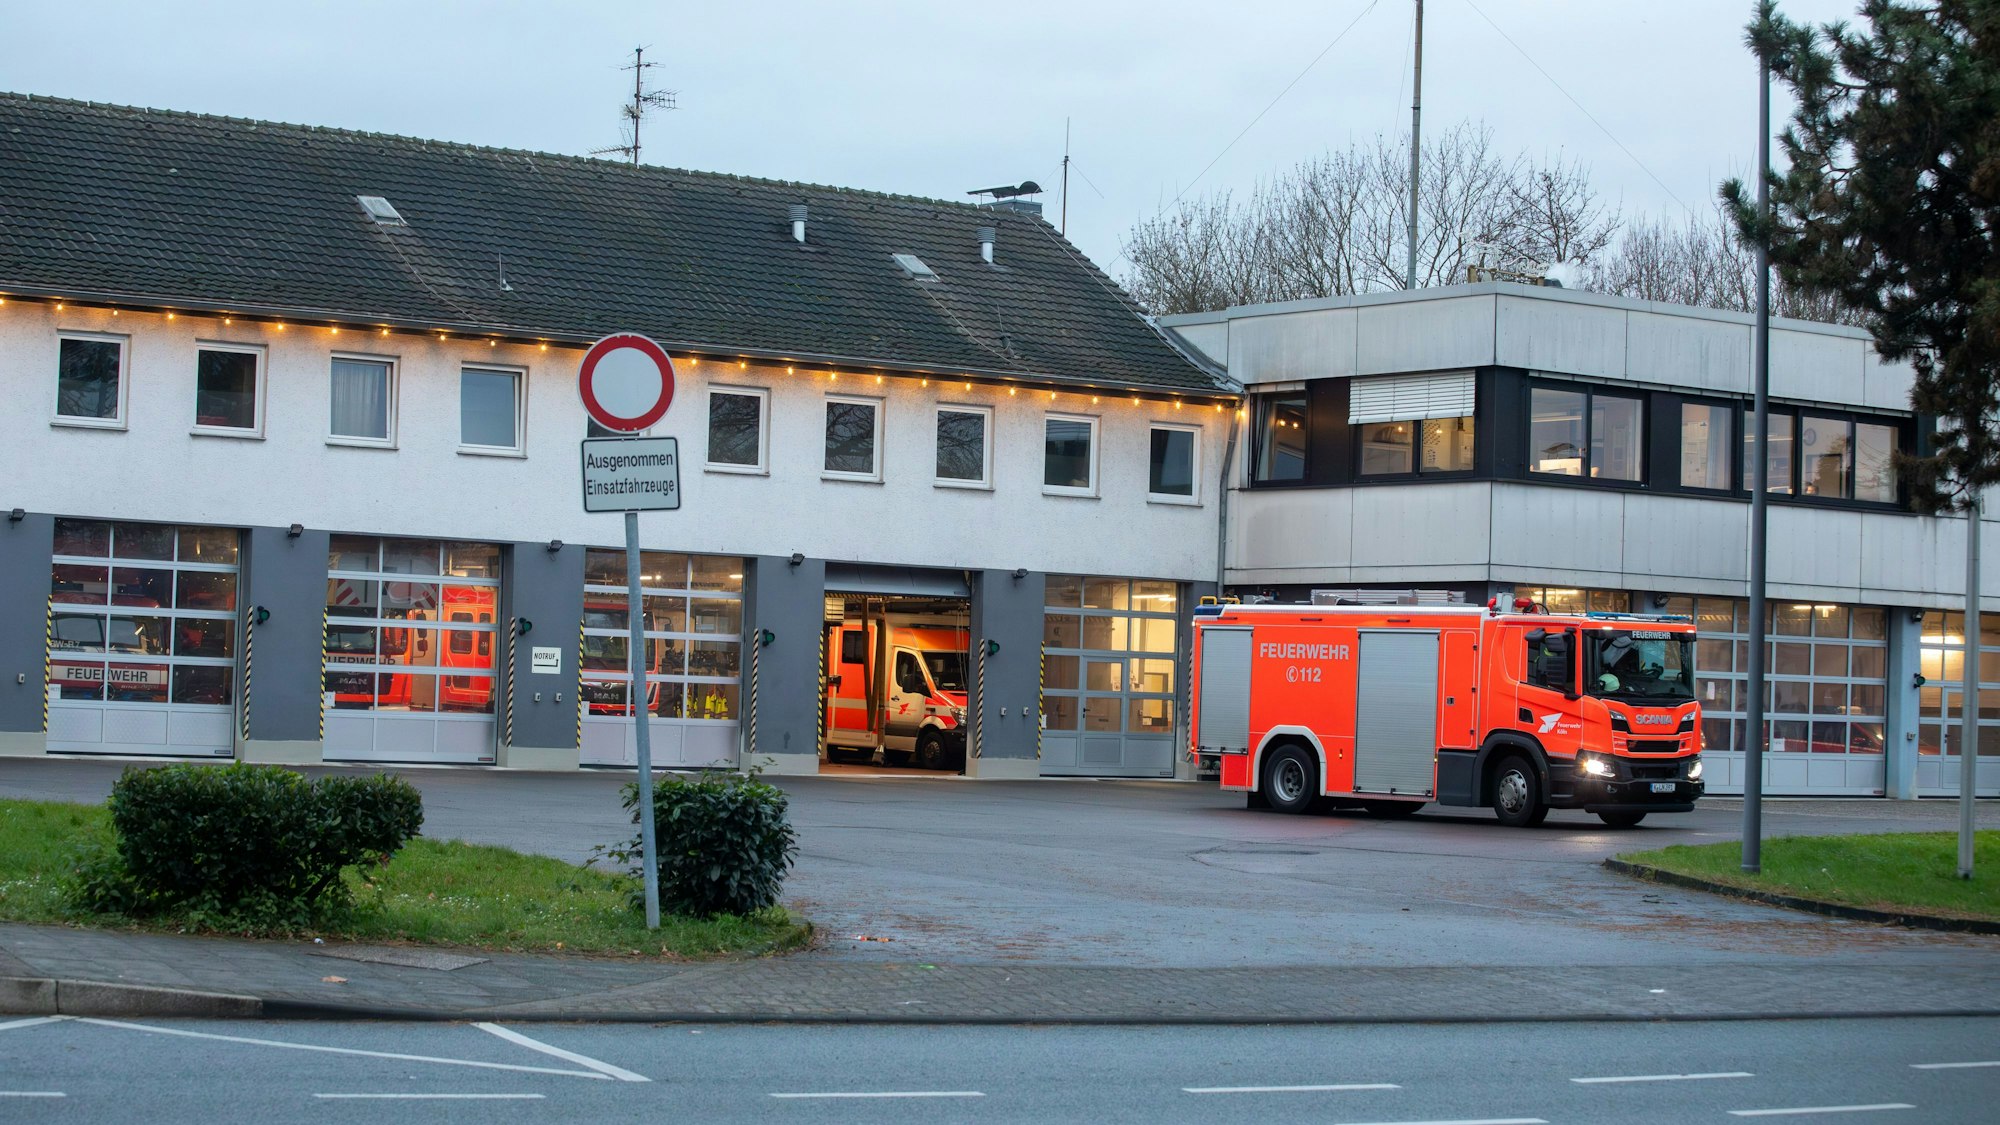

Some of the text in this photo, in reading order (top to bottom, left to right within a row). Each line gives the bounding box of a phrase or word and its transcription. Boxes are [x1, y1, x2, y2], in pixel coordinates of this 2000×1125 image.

[586, 453, 673, 472] Ausgenommen
[587, 478, 675, 496] Einsatzfahrzeuge
[1632, 631, 1671, 640] FEUERWEHR
[1260, 642, 1349, 660] FEUERWEHR
[534, 652, 556, 660] NOTRUF
[1300, 667, 1322, 682] 112
[339, 677, 367, 685] MAN
[593, 692, 619, 700] MAN
[1635, 714, 1673, 724] SCANIA
[1557, 721, 1582, 729] Feuerwehr
